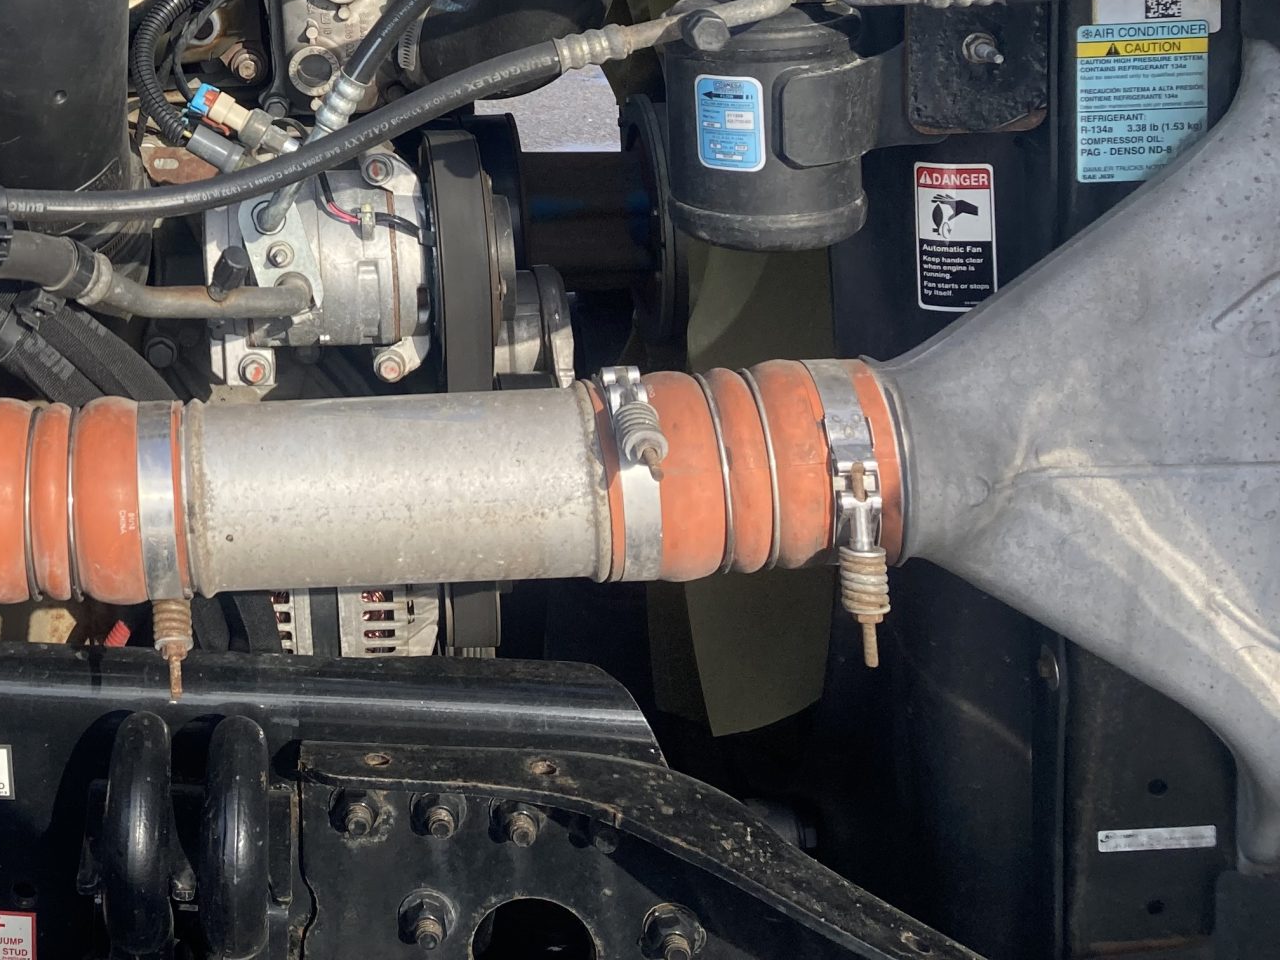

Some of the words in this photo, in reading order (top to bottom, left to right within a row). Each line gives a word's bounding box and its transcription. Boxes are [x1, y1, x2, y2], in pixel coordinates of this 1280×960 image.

[1094, 28, 1115, 38] AIR
[1118, 24, 1207, 38] CONDITIONER
[1124, 42, 1181, 54] CAUTION
[1120, 64, 1168, 72] REFRIGERANT
[465, 56, 553, 93] BURGAFLEX
[1080, 114, 1147, 123] REFRIGERANT:
[1080, 125, 1114, 134] R-134a
[1127, 124, 1147, 132] 3.38
[1150, 123, 1159, 131] lb
[1162, 122, 1185, 133] (1.53
[1188, 121, 1203, 132] kg)
[344, 123, 390, 150] GALAXY
[1080, 136, 1144, 146] COMPRESSOR
[1146, 135, 1165, 143] OIL:
[325, 148, 341, 160] SAE
[1080, 148, 1101, 157] PAG
[1110, 146, 1146, 156] DENSO
[284, 164, 303, 176] Type
[254, 175, 275, 186] Class
[932, 174, 989, 186] DANGER
[222, 184, 242, 196] 13/32
[922, 244, 964, 253] Automatic
[923, 255, 940, 263] Keep
[924, 272, 952, 280] running.
[2, 948, 28, 956] STUD
